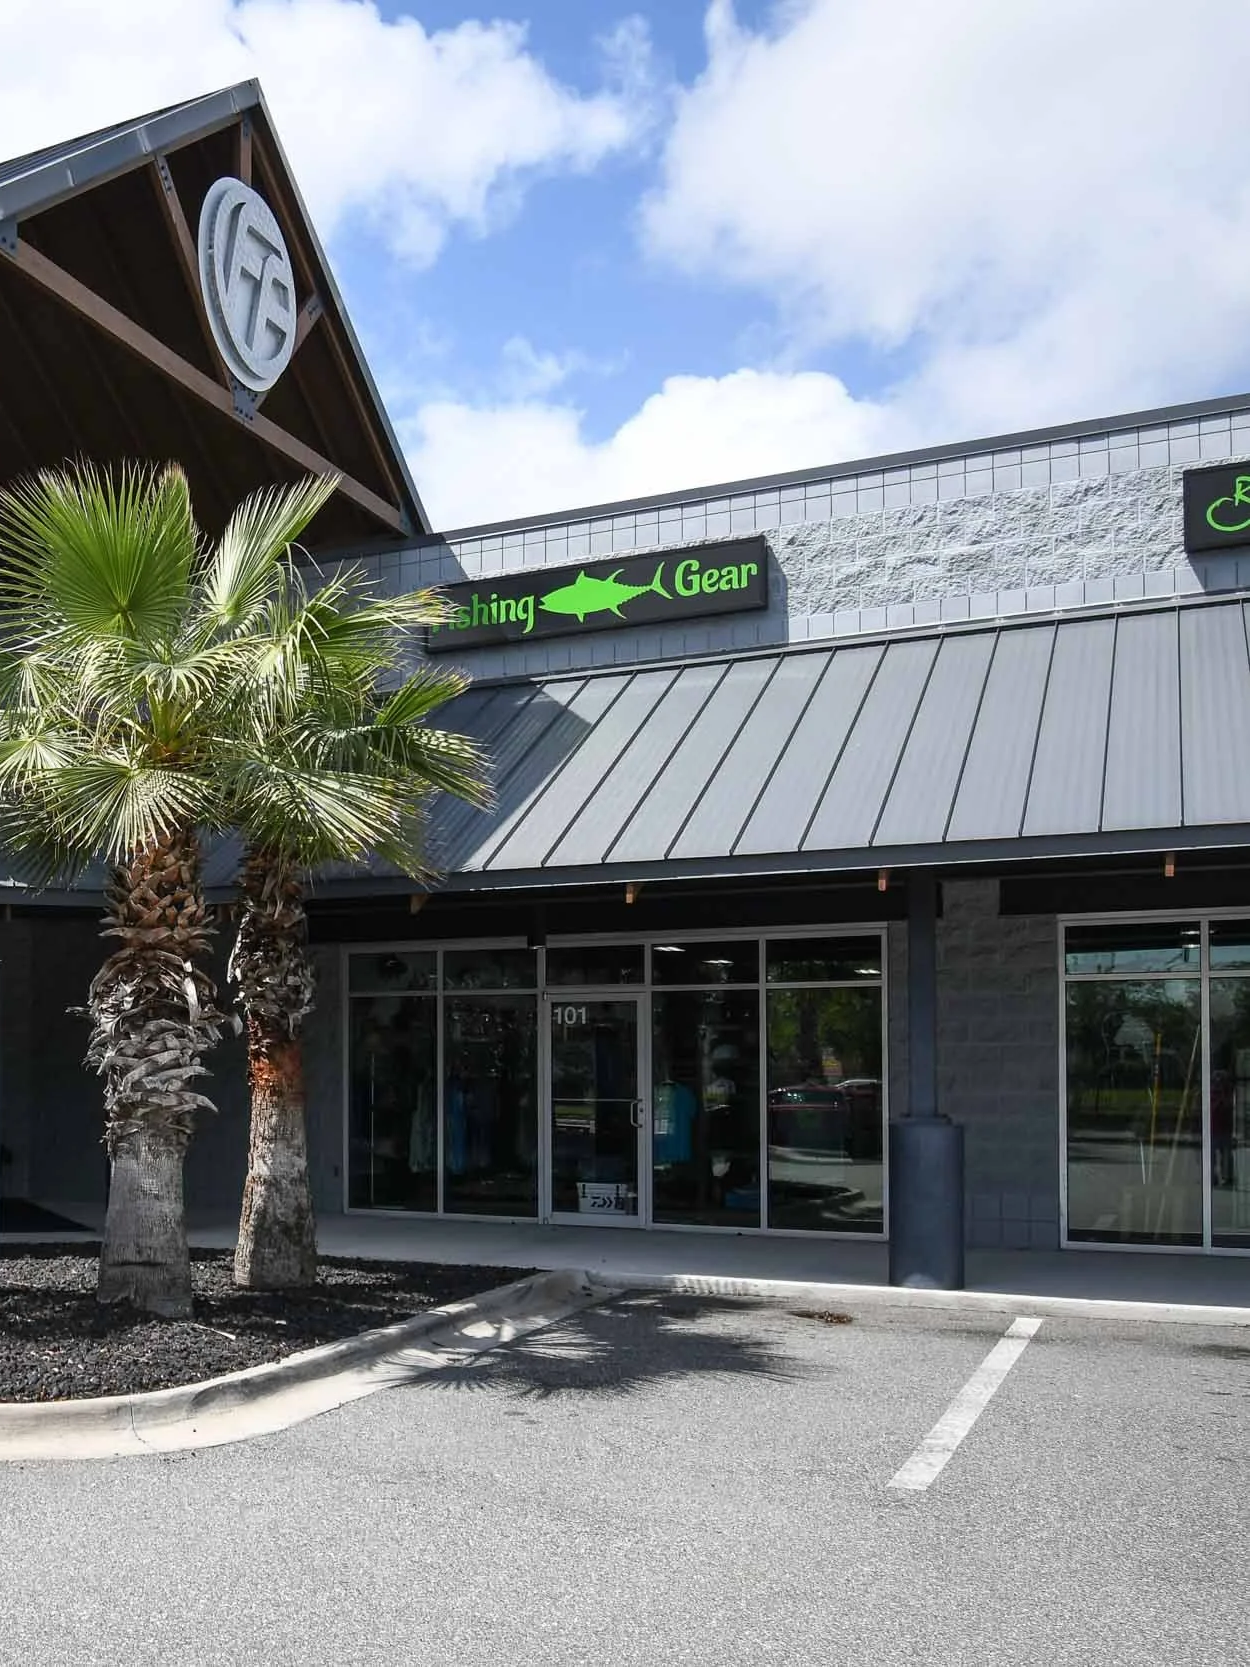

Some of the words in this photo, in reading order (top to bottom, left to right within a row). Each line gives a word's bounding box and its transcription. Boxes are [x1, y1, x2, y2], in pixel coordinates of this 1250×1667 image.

[432, 592, 535, 634] shing
[675, 559, 758, 597] Gear
[553, 1006, 586, 1025] 101
